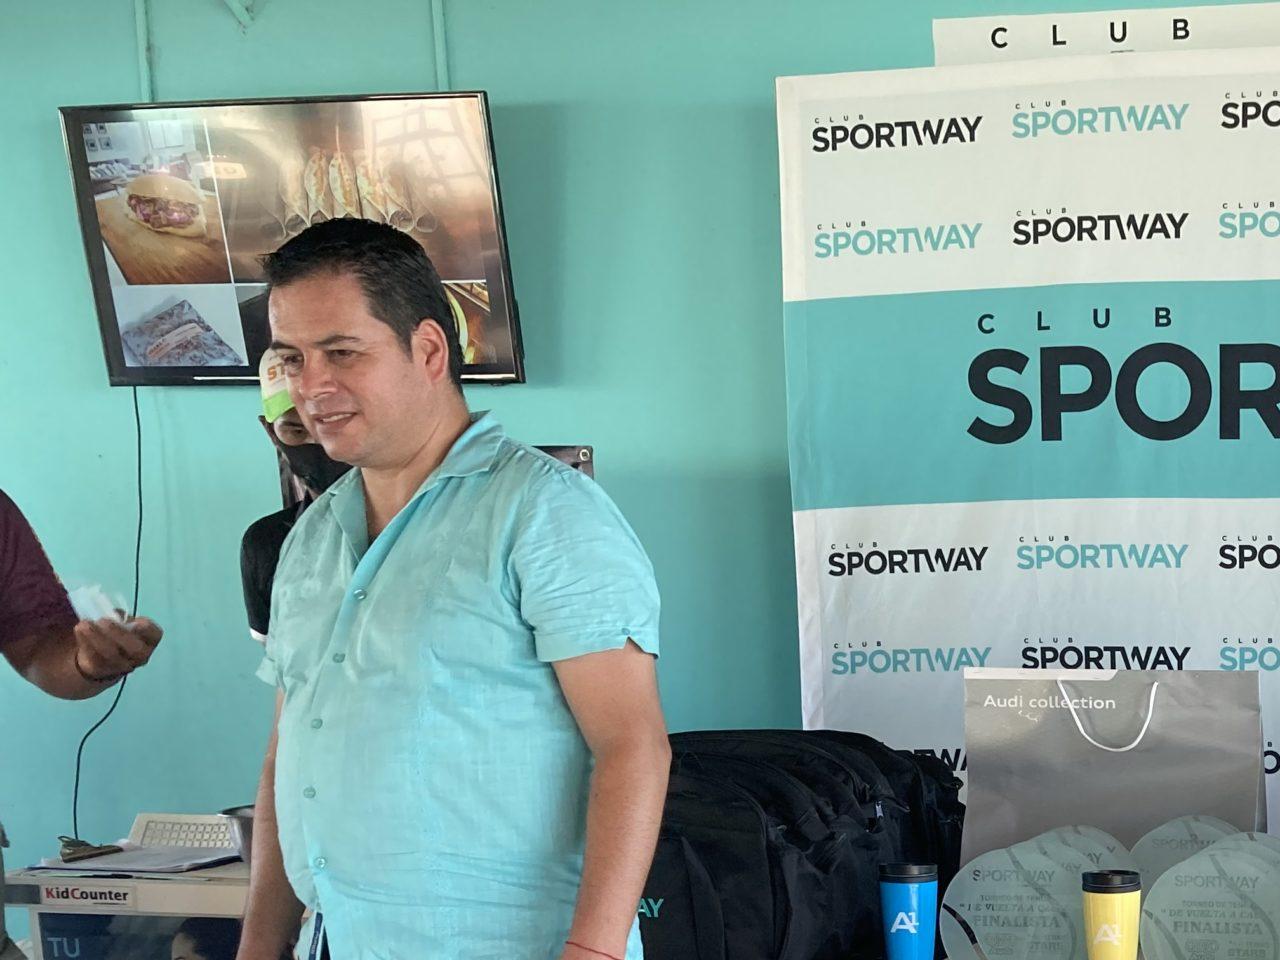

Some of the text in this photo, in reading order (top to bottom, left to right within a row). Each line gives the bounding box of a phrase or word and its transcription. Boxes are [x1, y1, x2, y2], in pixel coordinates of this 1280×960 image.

[991, 19, 1189, 48] CLUB
[1225, 90, 1278, 99] CLUB
[1015, 100, 1066, 110] CLUB
[814, 114, 864, 124] CLUB
[1012, 103, 1190, 139] SPORTWAY
[812, 116, 983, 152] SPORTWAY
[1016, 207, 1067, 217] CLUB
[1222, 202, 1275, 210] CLUB
[817, 220, 867, 231] CLUB
[1012, 212, 1189, 246] SPORTWAY
[814, 223, 983, 259] SPORTWAY
[977, 306, 1172, 335] CLUB
[1019, 535, 1069, 543] CLUB
[828, 546, 988, 577] SPORTWAY
[1016, 544, 1189, 570] SPORTWAY
[834, 641, 881, 649] CLUB
[831, 647, 992, 675] SPORTWAY
[1021, 646, 1191, 670] SPORTWAY
[984, 694, 1116, 710] Audi collection
[45, 887, 129, 901] KidCounter
[1173, 920, 1263, 935] FINALISTA
[48, 937, 80, 958] TU
